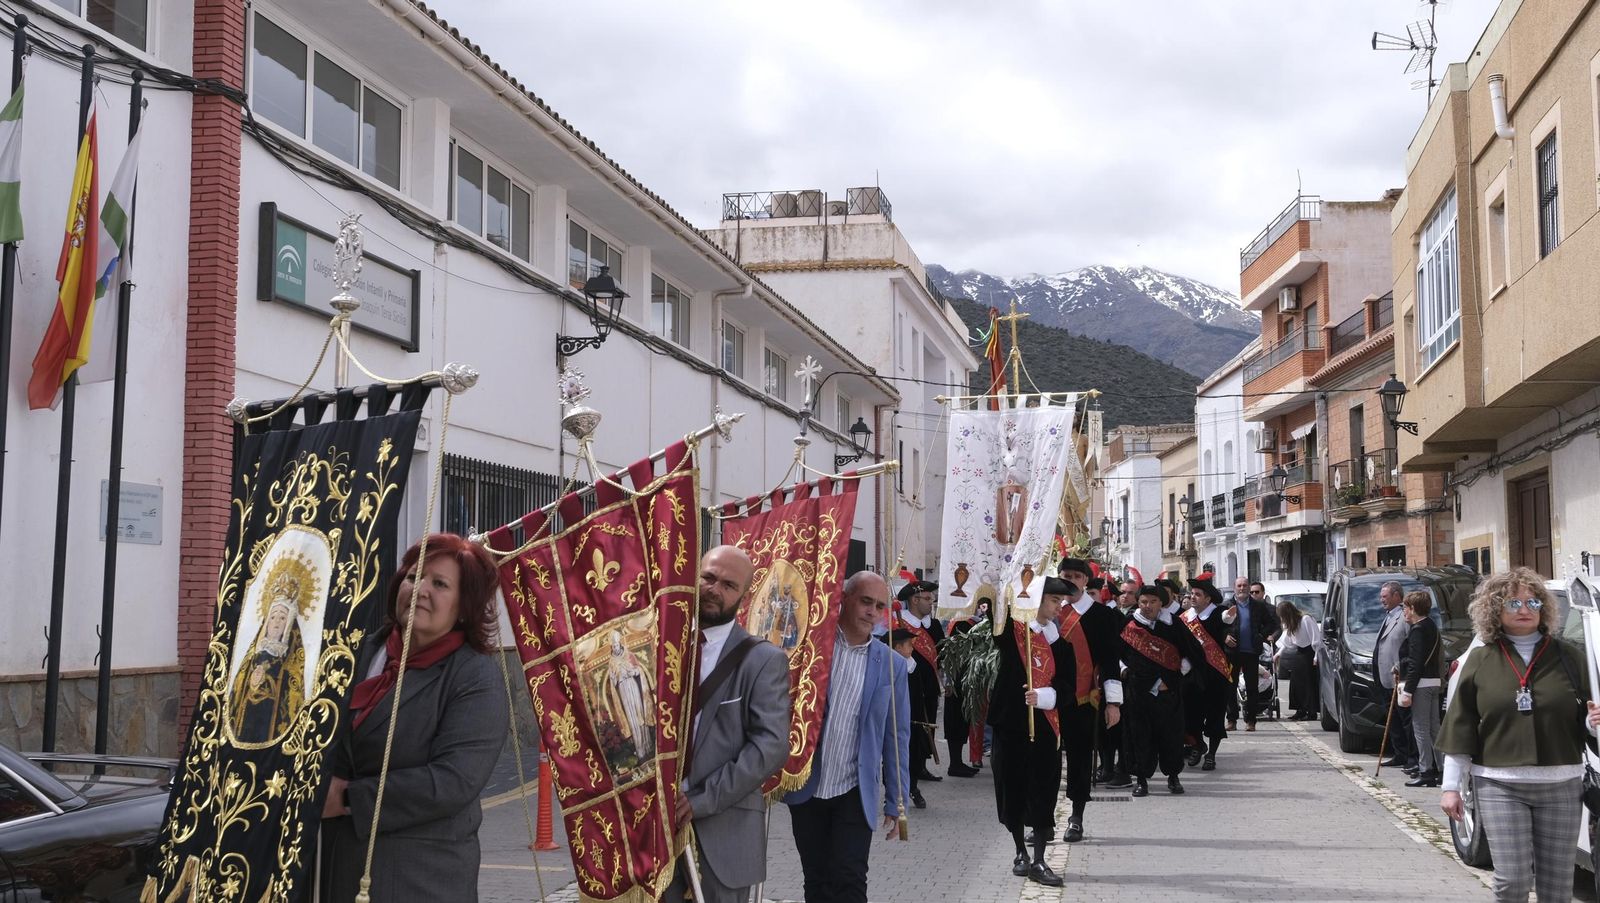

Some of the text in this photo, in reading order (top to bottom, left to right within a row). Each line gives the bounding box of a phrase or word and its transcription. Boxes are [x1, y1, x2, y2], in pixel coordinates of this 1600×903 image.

[313, 258, 333, 279] Colegio
[366, 280, 383, 298] Infantil
[383, 291, 388, 302] y
[388, 289, 407, 308] Primaria
